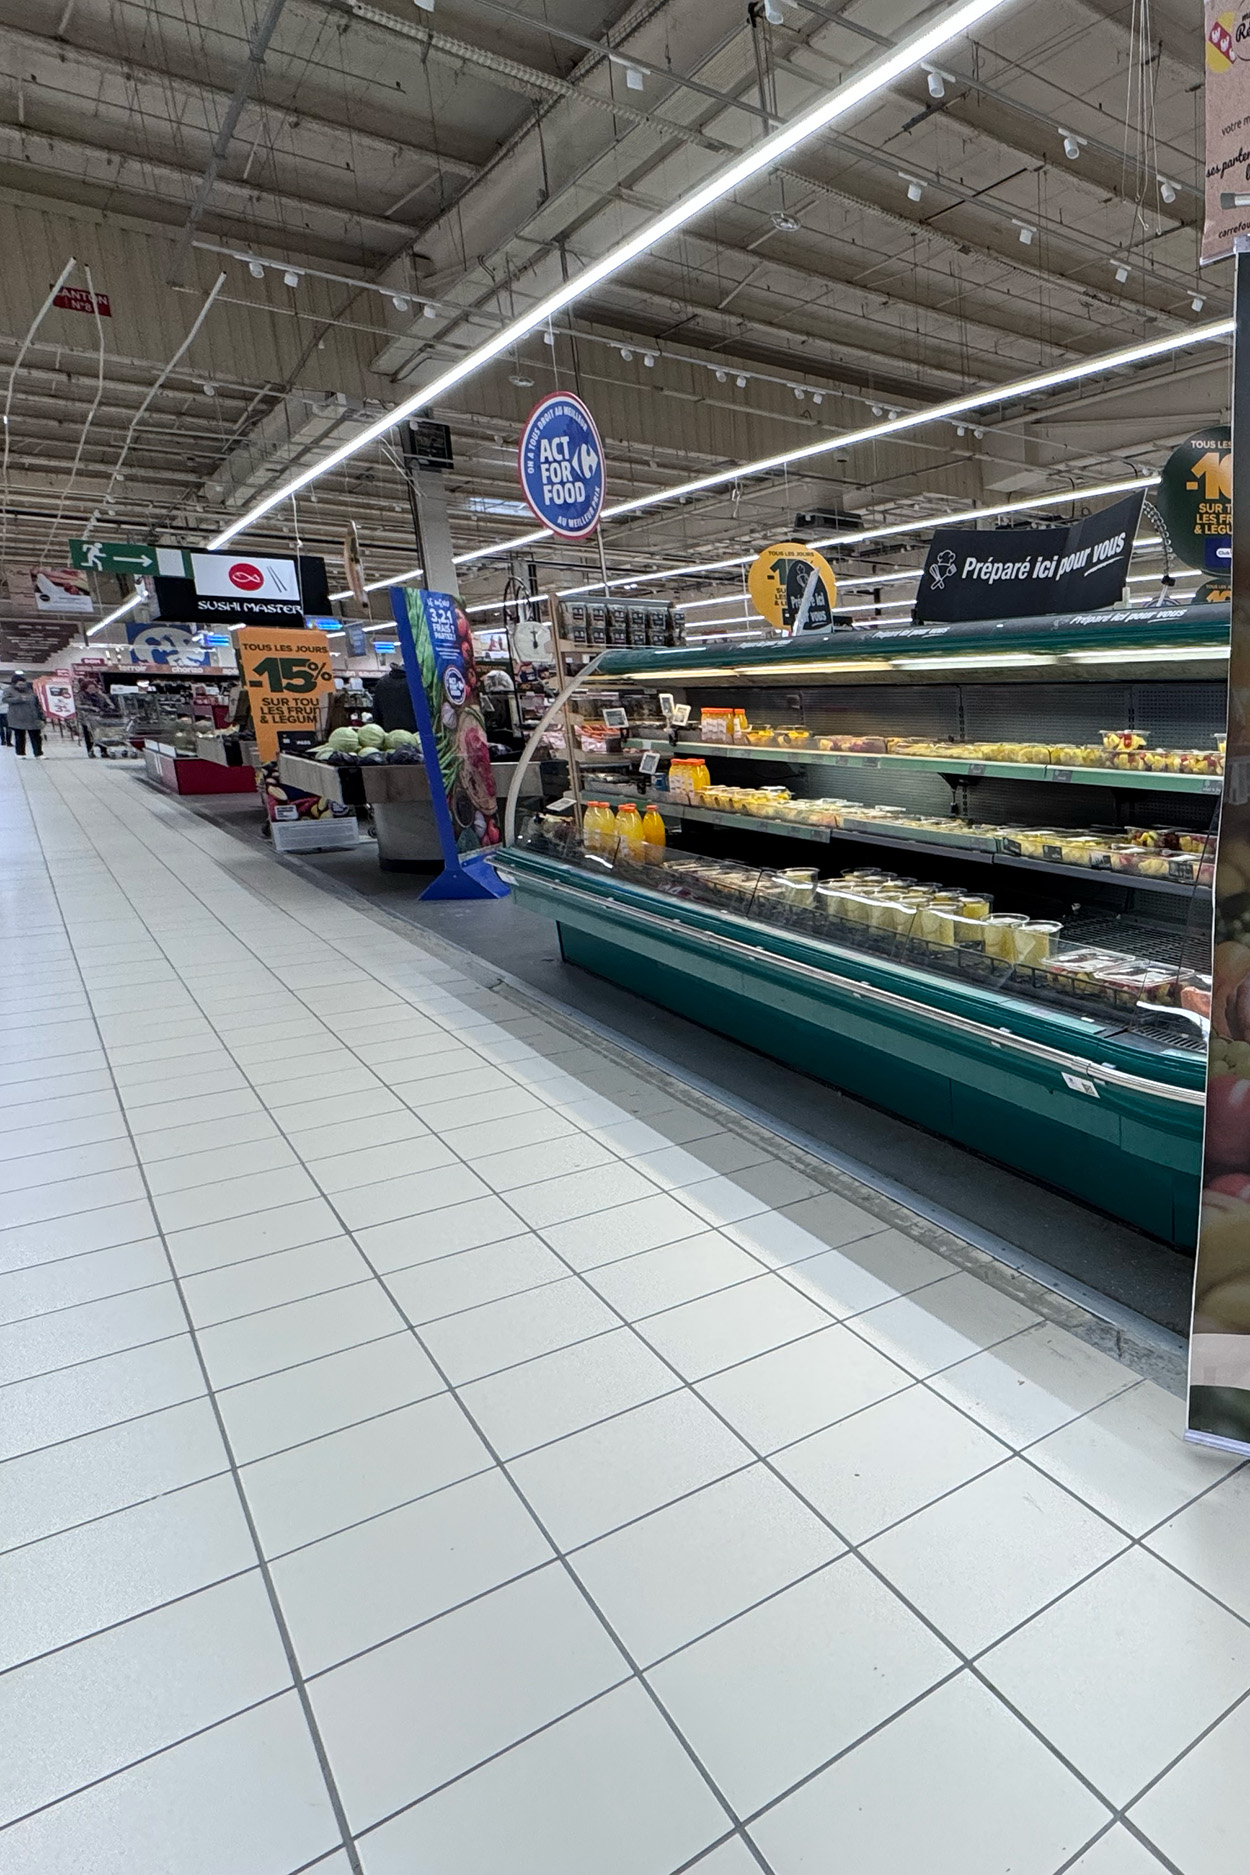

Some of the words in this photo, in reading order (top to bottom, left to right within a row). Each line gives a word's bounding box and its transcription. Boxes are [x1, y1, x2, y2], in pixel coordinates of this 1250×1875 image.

[1221, 119, 1242, 136] votre
[1206, 165, 1220, 178] ses
[55, 288, 108, 305] ANTN
[528, 428, 541, 451] TOUS
[538, 409, 555, 430] DROIT
[539, 435, 570, 463] ACT
[1190, 440, 1216, 449] TOUS
[1217, 440, 1232, 449] LES
[540, 461, 574, 485] FOR
[543, 481, 586, 506] FOOD
[592, 486, 601, 510] PRIX
[1199, 503, 1223, 514] SUR
[1196, 515, 1216, 524] LES
[1194, 525, 1203, 535] &
[1204, 521, 1232, 535] LÉGU
[961, 556, 1032, 585] Préparé
[1032, 555, 1059, 579] ici
[1055, 546, 1092, 581] pour
[1092, 532, 1126, 564] vous
[198, 600, 241, 612] SUSHI
[243, 602, 304, 615] MASTER
[1070, 614, 1112, 625] Préparé
[1111, 612, 1128, 622] ici
[1125, 612, 1158, 623] pour
[1156, 609, 1187, 618] vous
[242, 643, 272, 652] TOUS
[274, 644, 293, 653] LES
[294, 645, 328, 654] JOURS
[248, 656, 333, 694] -15%
[261, 697, 290, 707] SUR
[292, 697, 320, 707] TOU
[260, 706, 284, 716] LES
[260, 715, 269, 724] &
